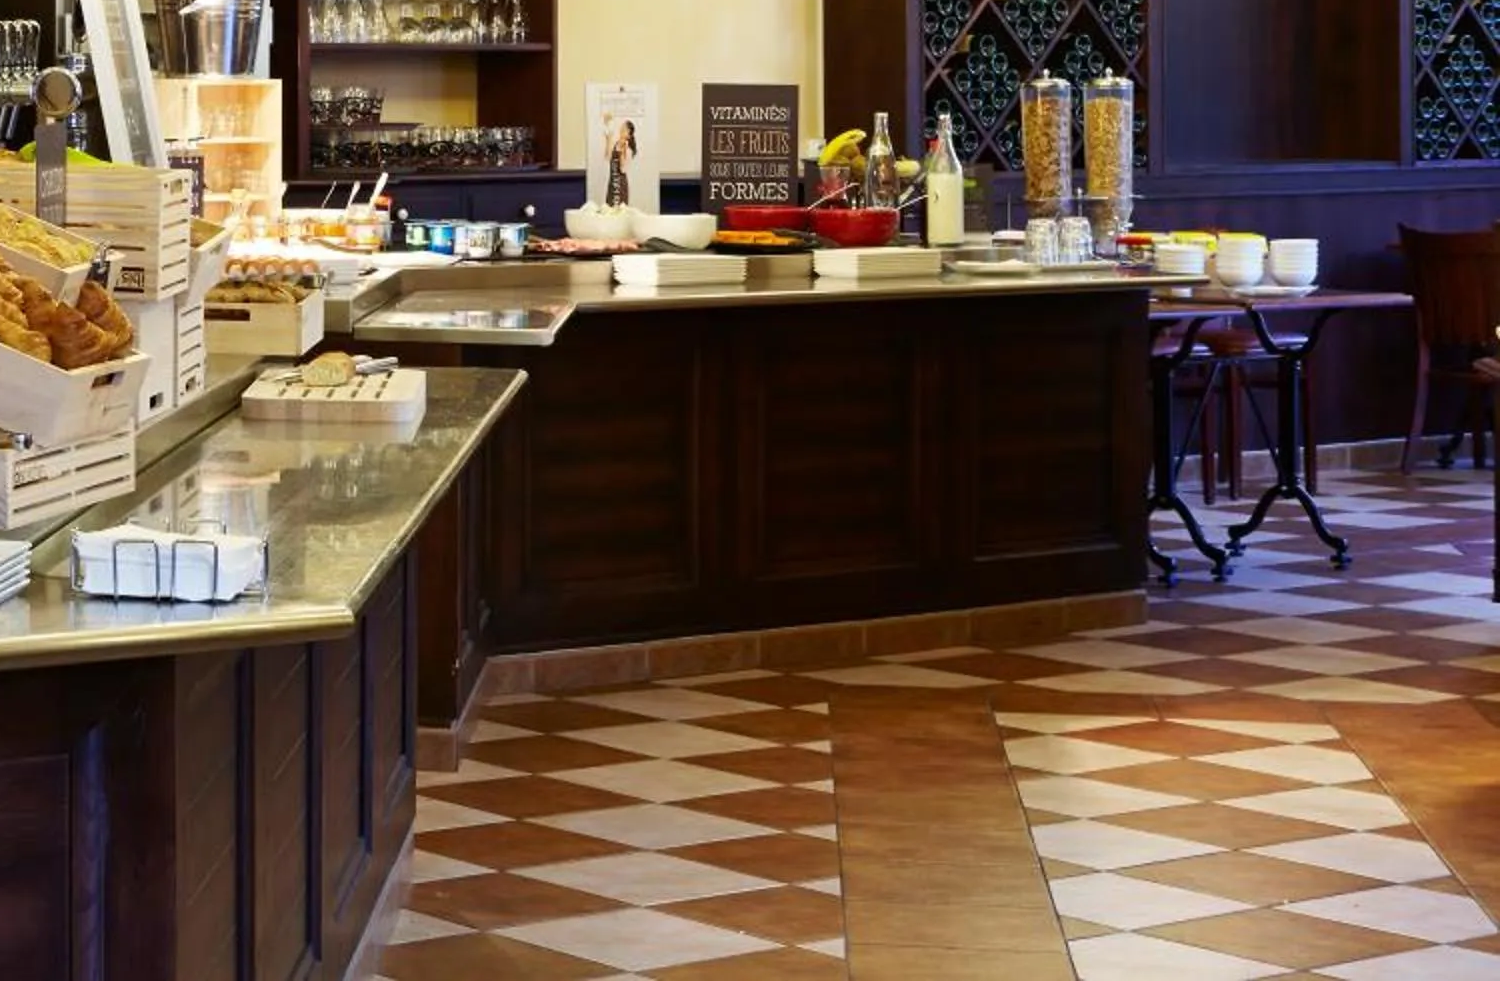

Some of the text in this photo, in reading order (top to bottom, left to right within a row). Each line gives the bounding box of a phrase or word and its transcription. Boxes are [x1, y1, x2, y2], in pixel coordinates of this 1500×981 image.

[710, 129, 789, 154] LES FRUITS
[709, 181, 789, 200] FORMES
